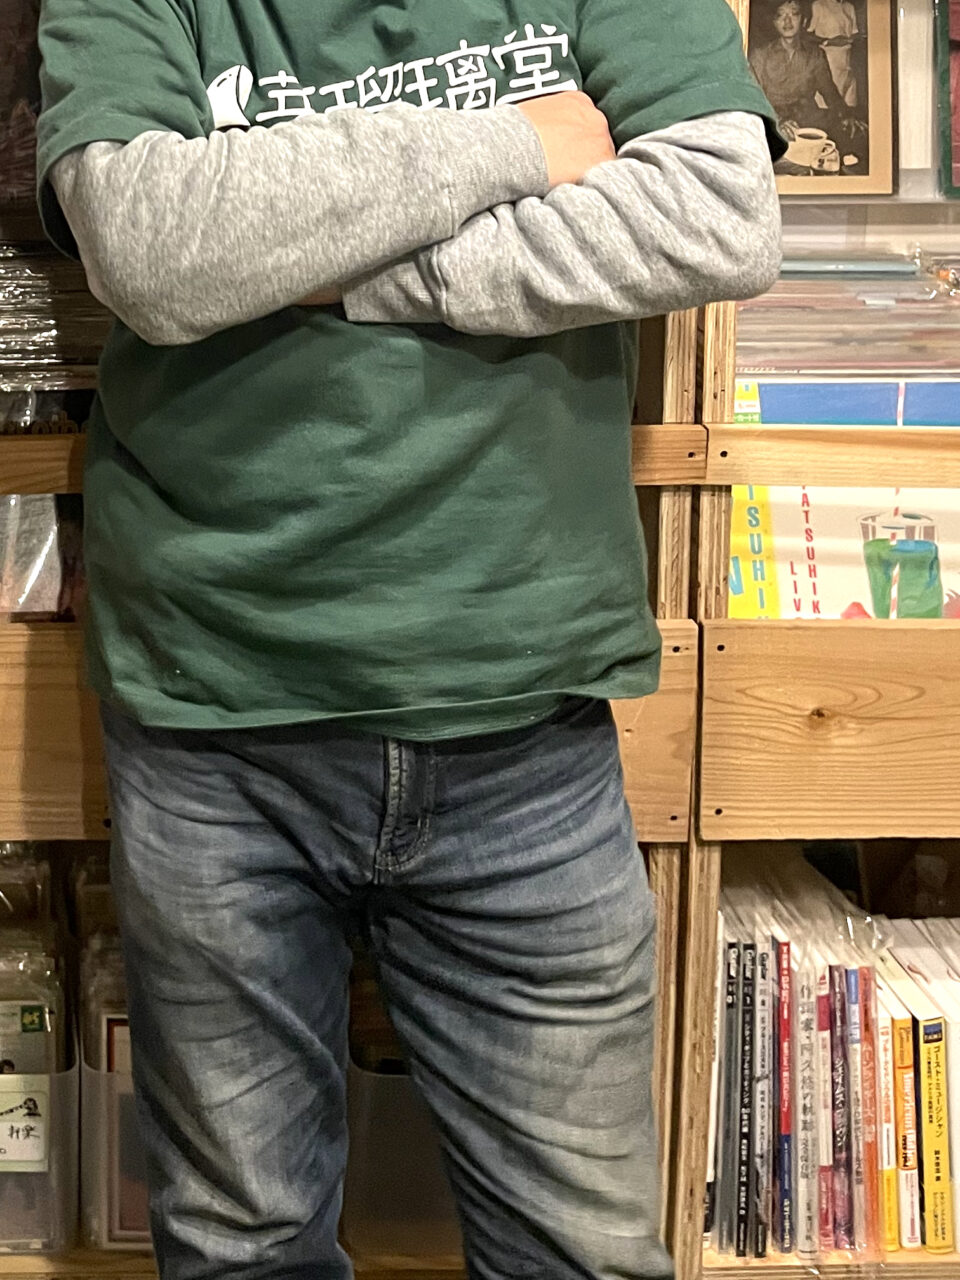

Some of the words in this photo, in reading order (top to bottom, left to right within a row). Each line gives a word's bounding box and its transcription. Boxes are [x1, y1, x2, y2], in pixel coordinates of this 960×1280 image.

[934, 1046, 945, 1138] ゴースト・ミュージシャン
